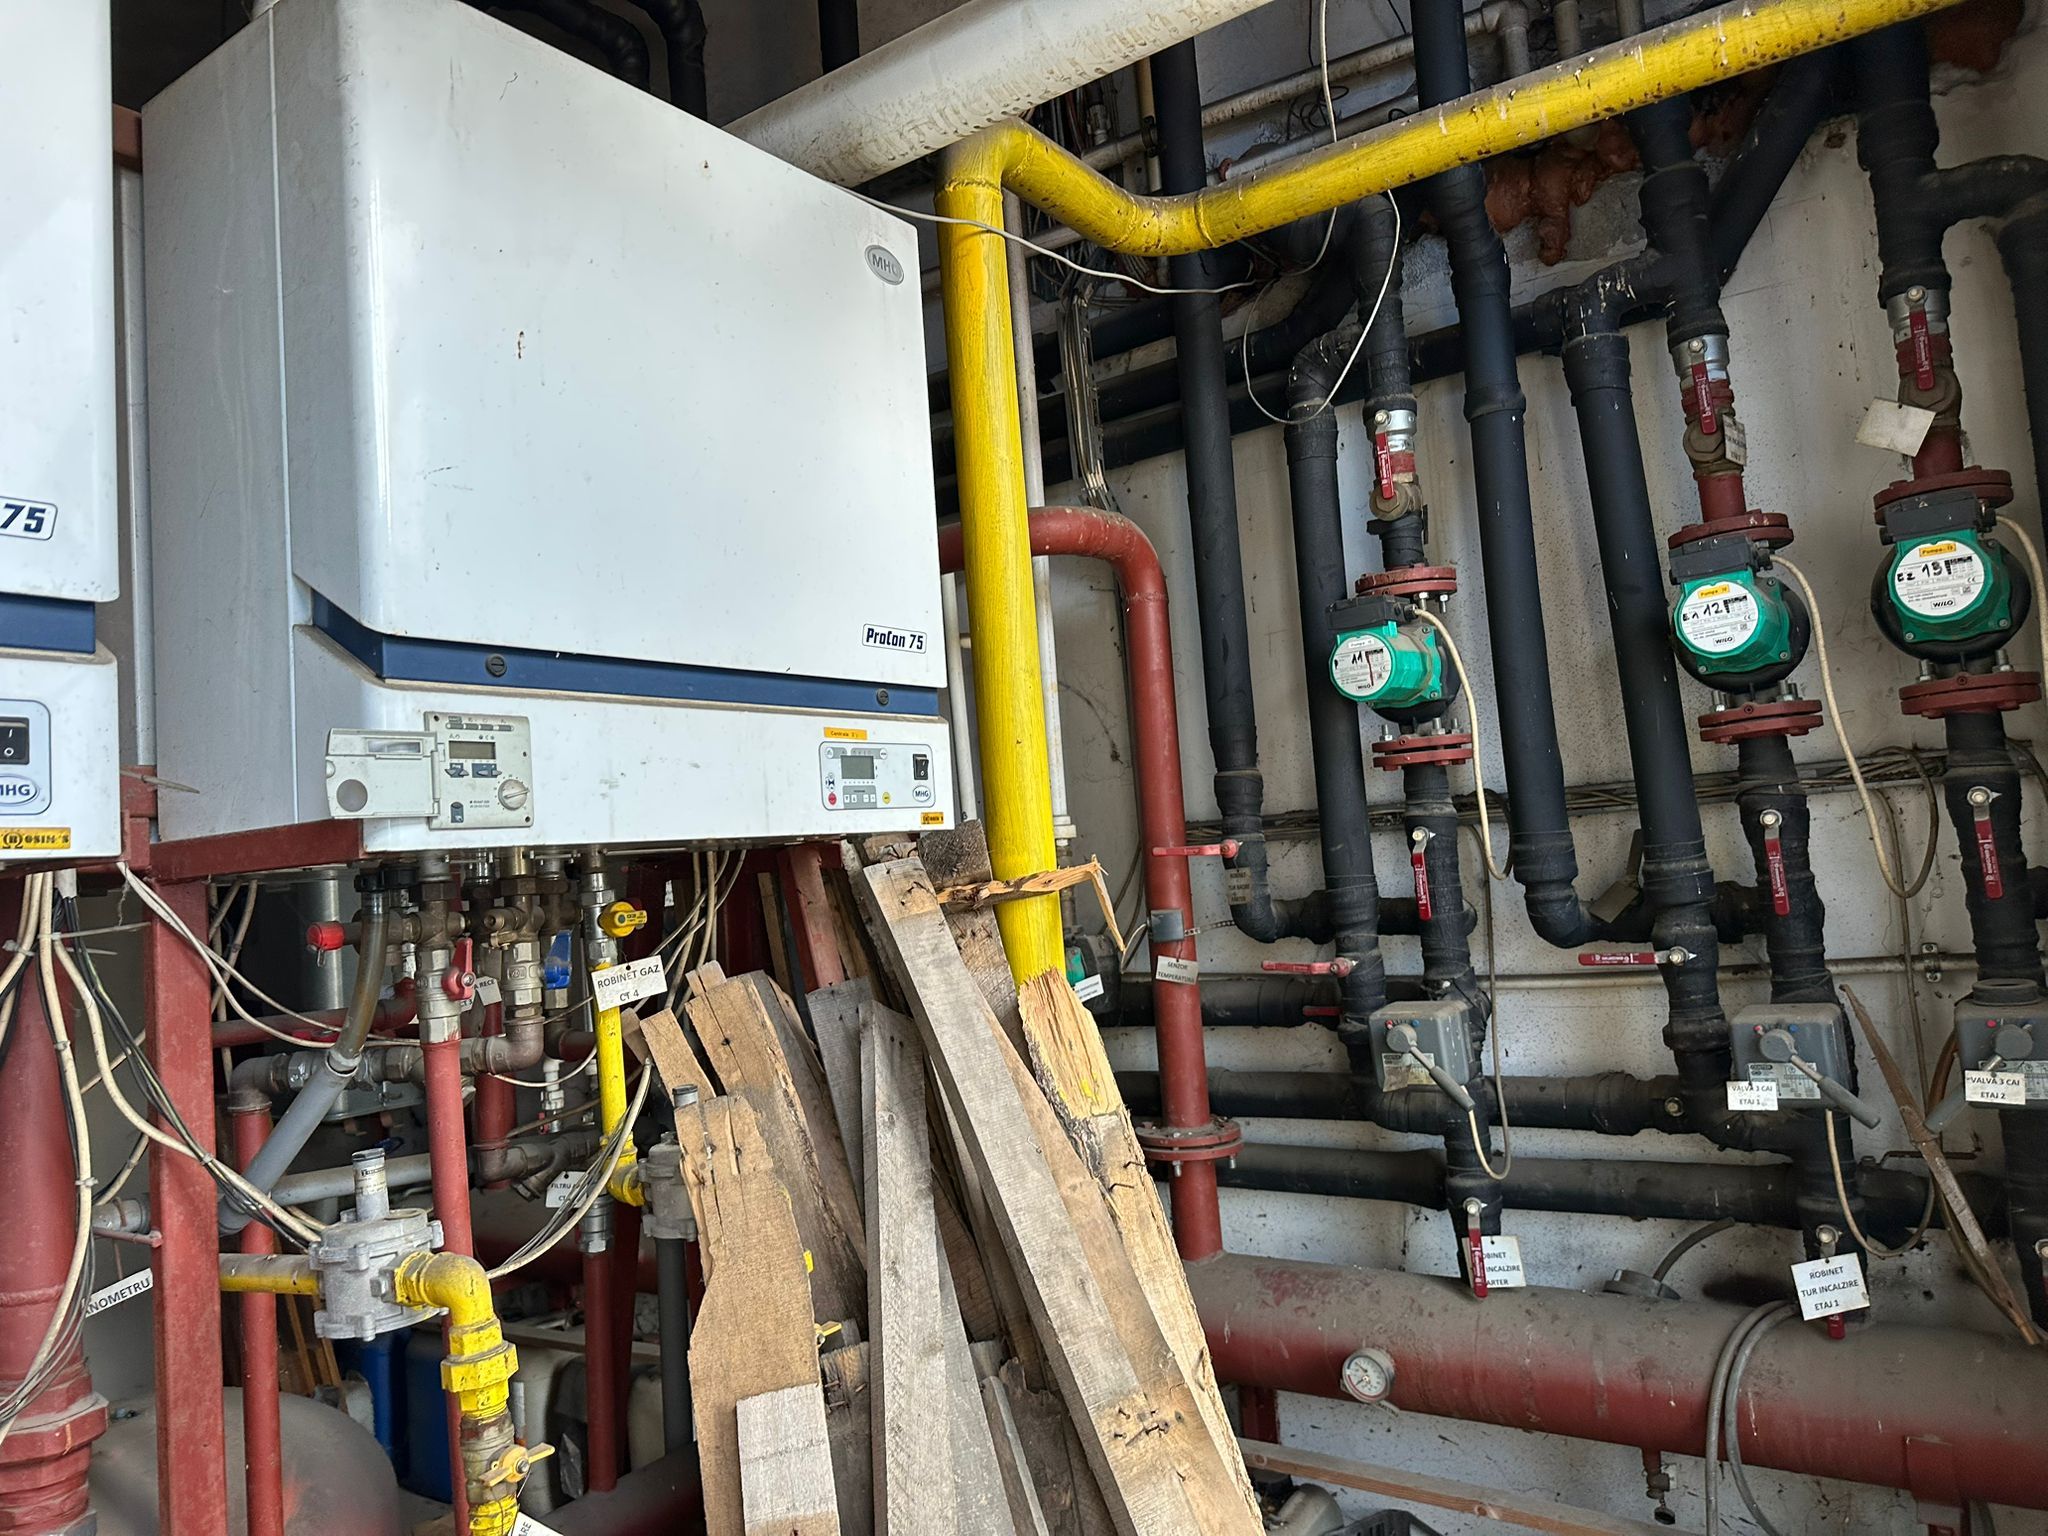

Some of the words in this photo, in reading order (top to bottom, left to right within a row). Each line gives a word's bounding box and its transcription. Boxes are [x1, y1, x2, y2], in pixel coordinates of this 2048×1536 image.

[0, 503, 47, 533] 75
[1703, 602, 1723, 617] 12
[1933, 600, 1954, 608] WILO
[909, 634, 924, 650] 75
[1715, 636, 1733, 644] WILO
[597, 970, 638, 989] ROBINET
[639, 964, 661, 977] GAZ
[619, 991, 630, 1002] CT
[633, 989, 640, 997] 4
[1981, 1091, 1999, 1099] ETAJ
[1809, 1266, 1844, 1280] ROBINET
[1801, 1289, 1818, 1298] TUR
[1818, 1279, 1860, 1294] INCALZIRE
[1814, 1301, 1834, 1311] ETAJ
